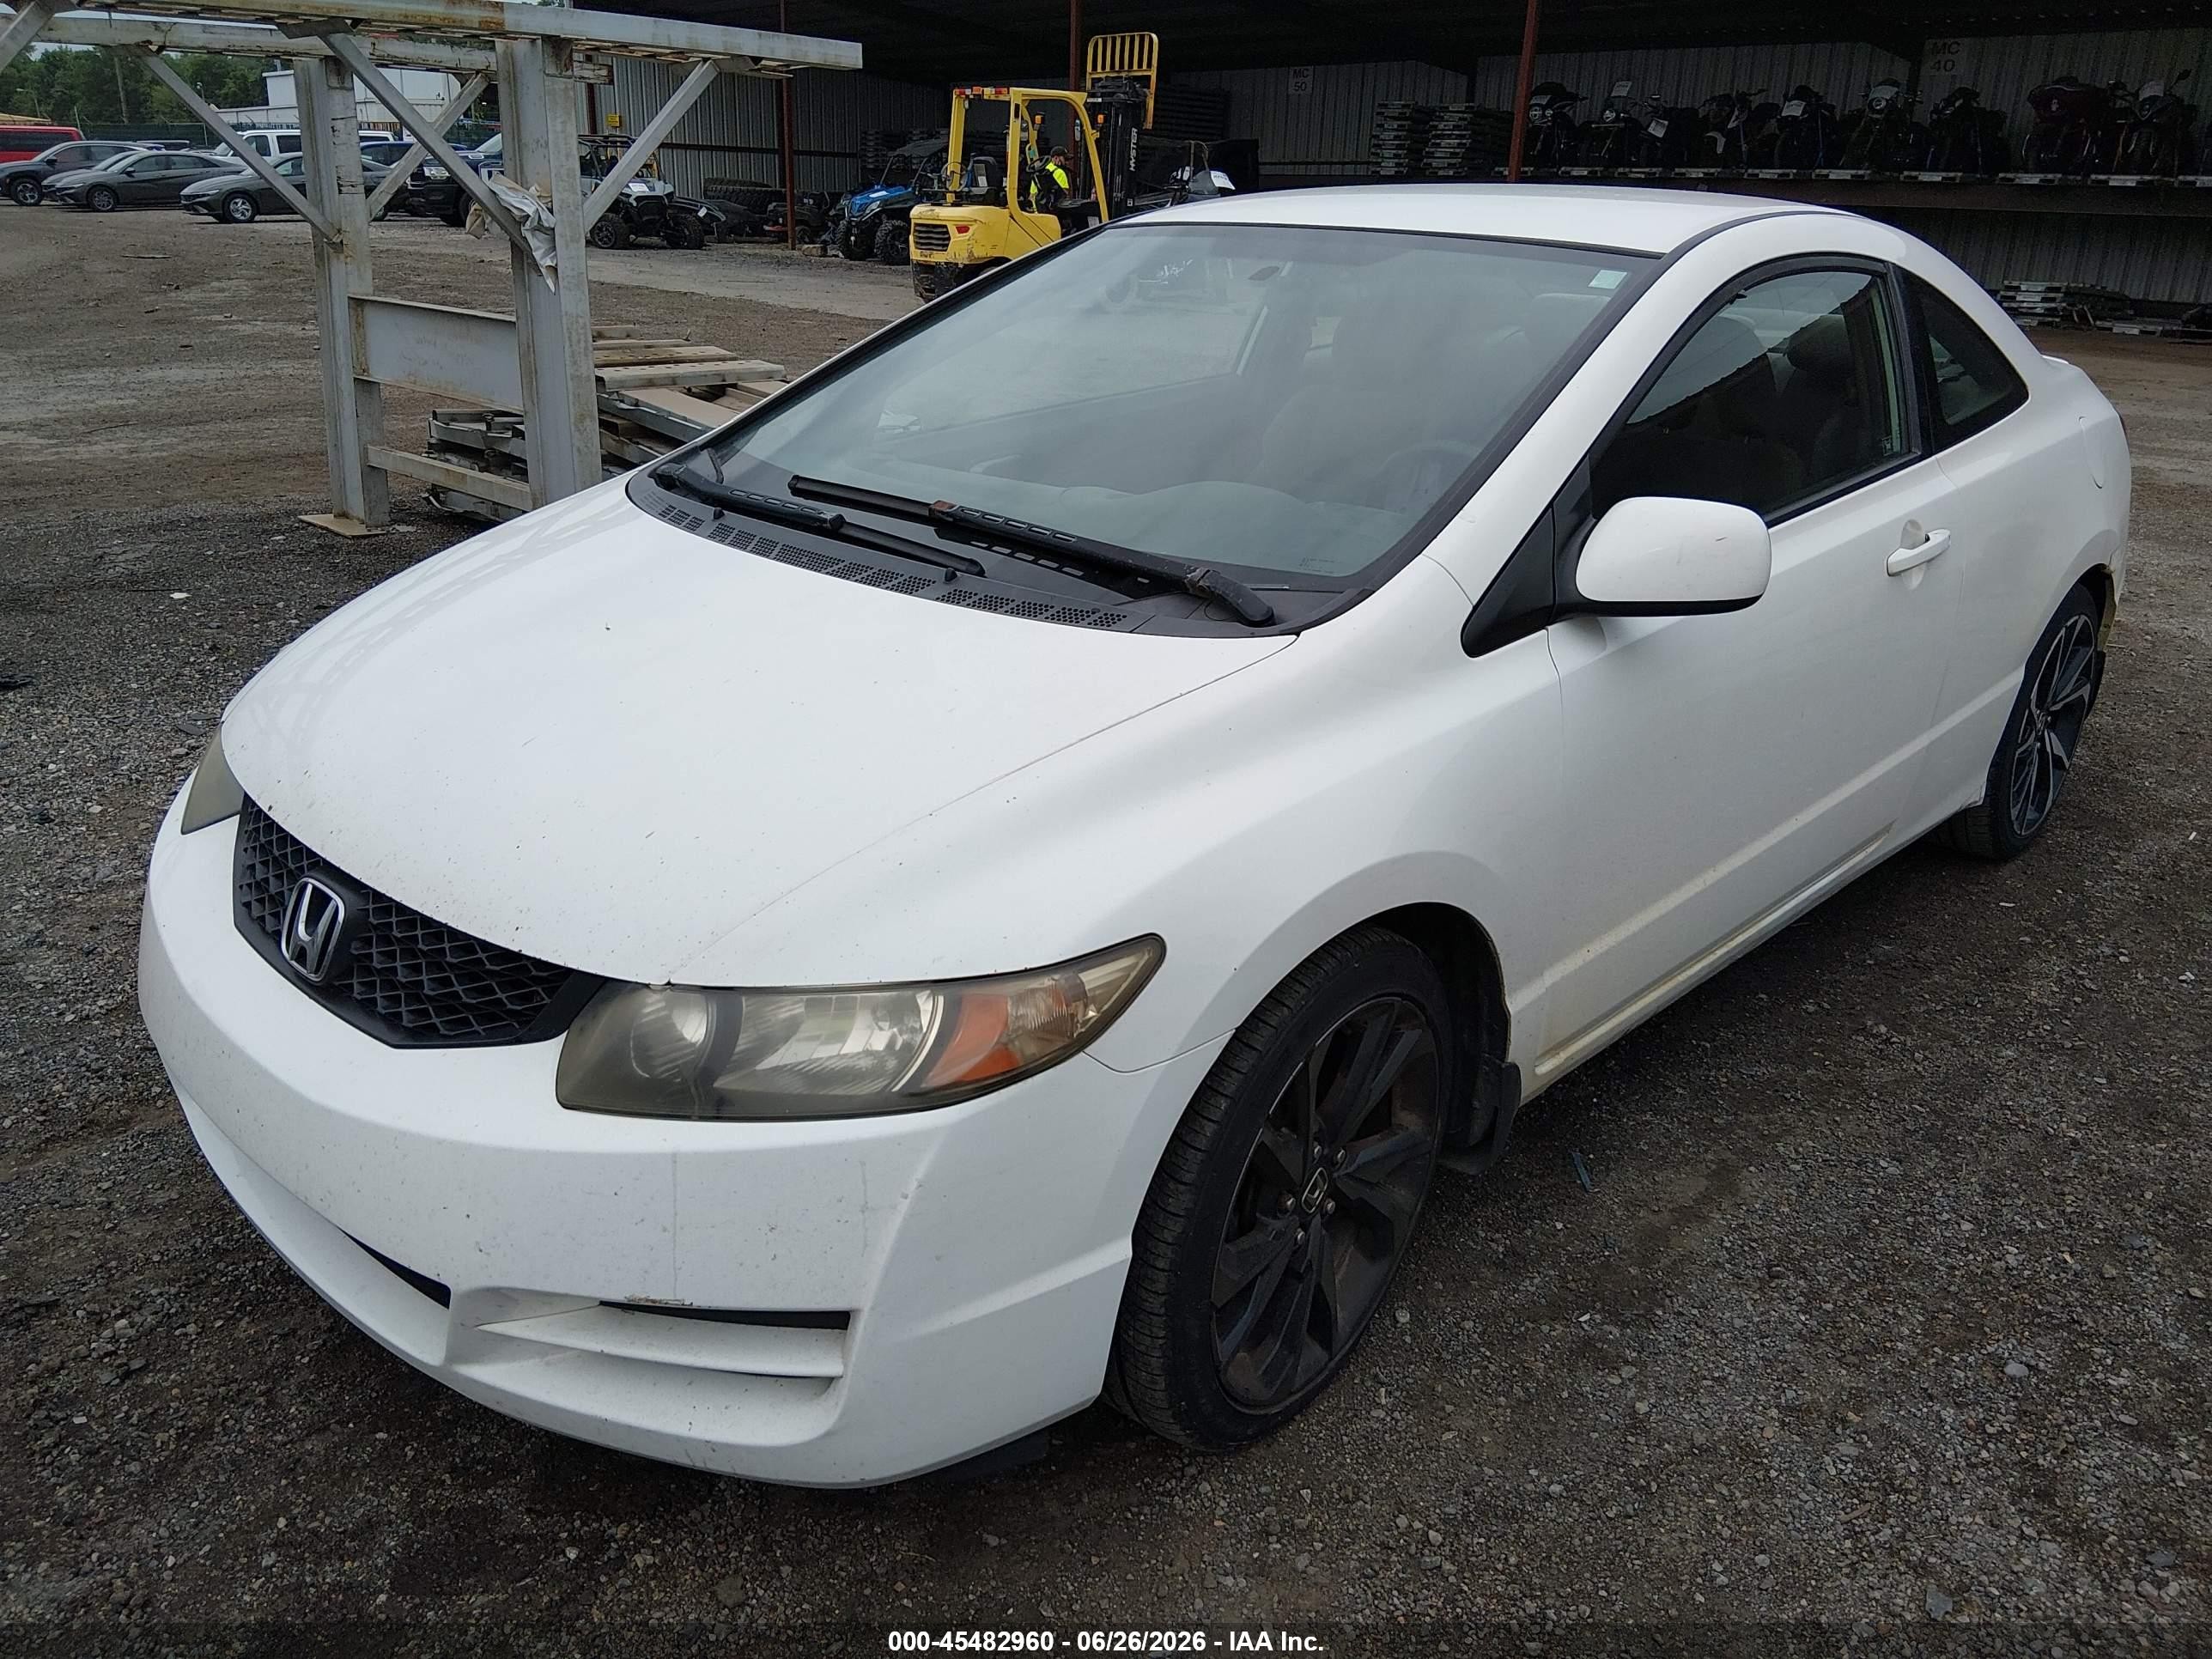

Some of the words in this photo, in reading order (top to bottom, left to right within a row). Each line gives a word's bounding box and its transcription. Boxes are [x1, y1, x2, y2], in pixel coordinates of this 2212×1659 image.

[1930, 41, 1961, 55] MC
[1929, 59, 1956, 72] 40
[1292, 68, 1310, 78] MC
[1293, 81, 1307, 92] 50
[1128, 126, 1139, 172] HYSTER
